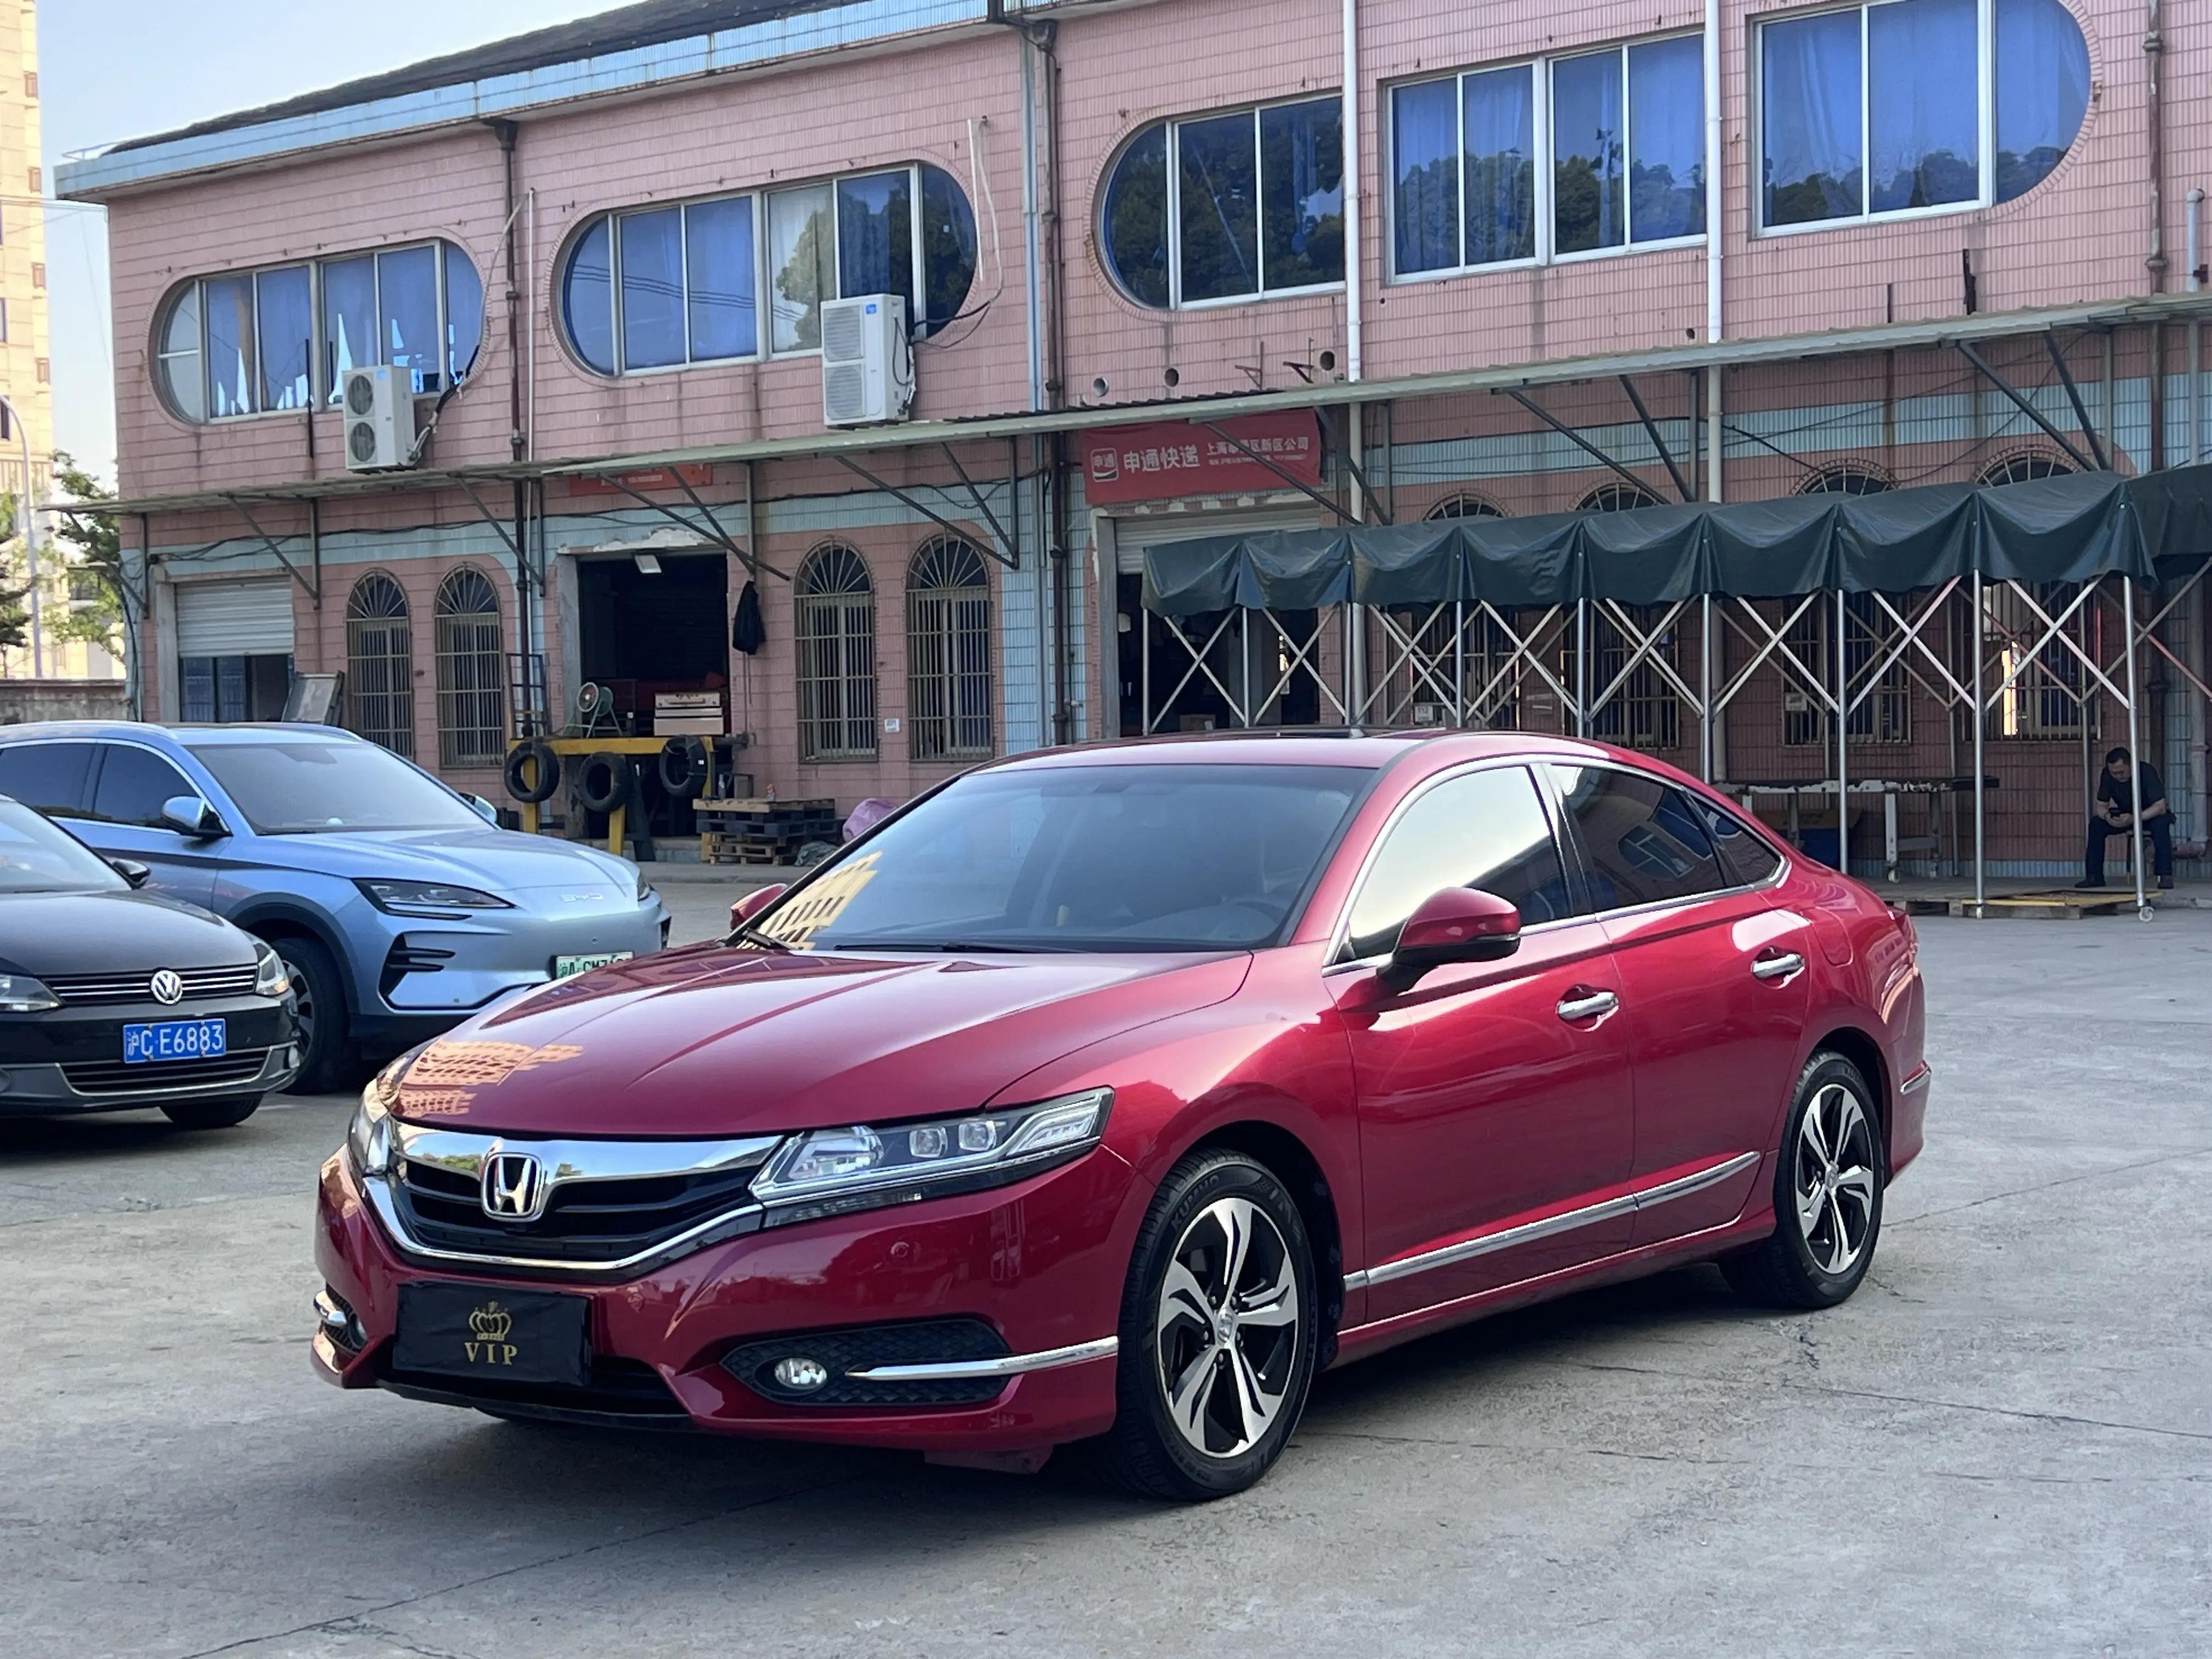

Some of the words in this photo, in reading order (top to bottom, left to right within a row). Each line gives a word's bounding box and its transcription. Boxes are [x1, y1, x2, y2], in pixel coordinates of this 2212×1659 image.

[1124, 444, 1200, 473] 申通快递
[464, 1342, 517, 1365] VIP
